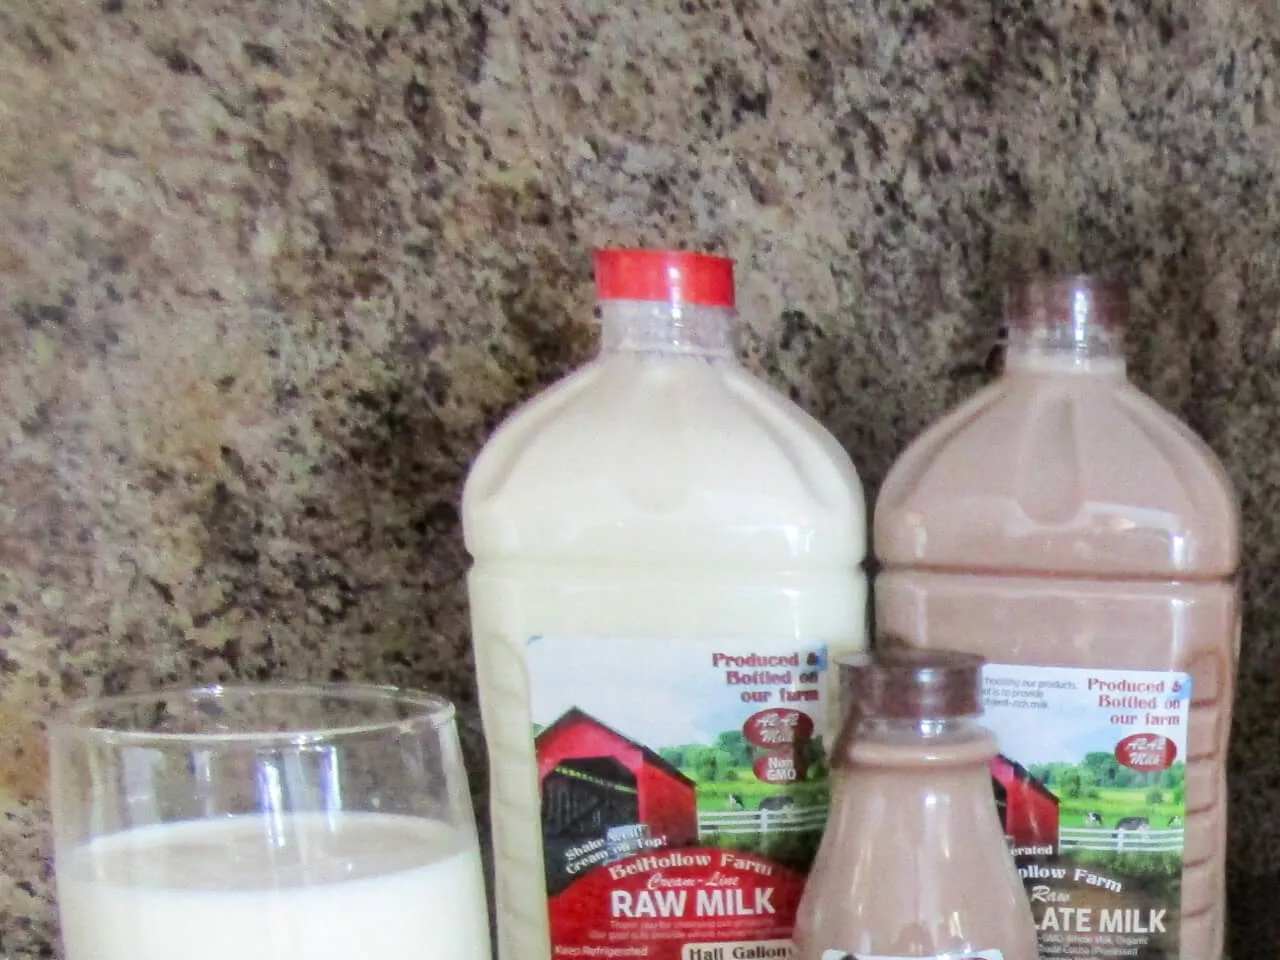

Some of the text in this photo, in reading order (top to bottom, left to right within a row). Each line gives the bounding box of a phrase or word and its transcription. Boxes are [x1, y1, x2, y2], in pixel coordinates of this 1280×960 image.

[712, 651, 799, 668] Produced
[726, 670, 792, 685] Bottled
[1087, 677, 1165, 693] Produced
[740, 690, 772, 703] our
[1098, 694, 1157, 710] Bottled
[1110, 713, 1181, 726] our farm
[768, 757, 794, 769] Non
[766, 768, 797, 781] GMO
[564, 838, 605, 861] Shake
[565, 850, 609, 875] Cream
[608, 852, 773, 880] BelHollow Farm
[1018, 865, 1123, 893] ollow Farm
[1031, 885, 1071, 903] Raw
[610, 887, 776, 918] RAW MILK
[1098, 907, 1167, 933] MILK
[732, 946, 787, 960] Gallon
